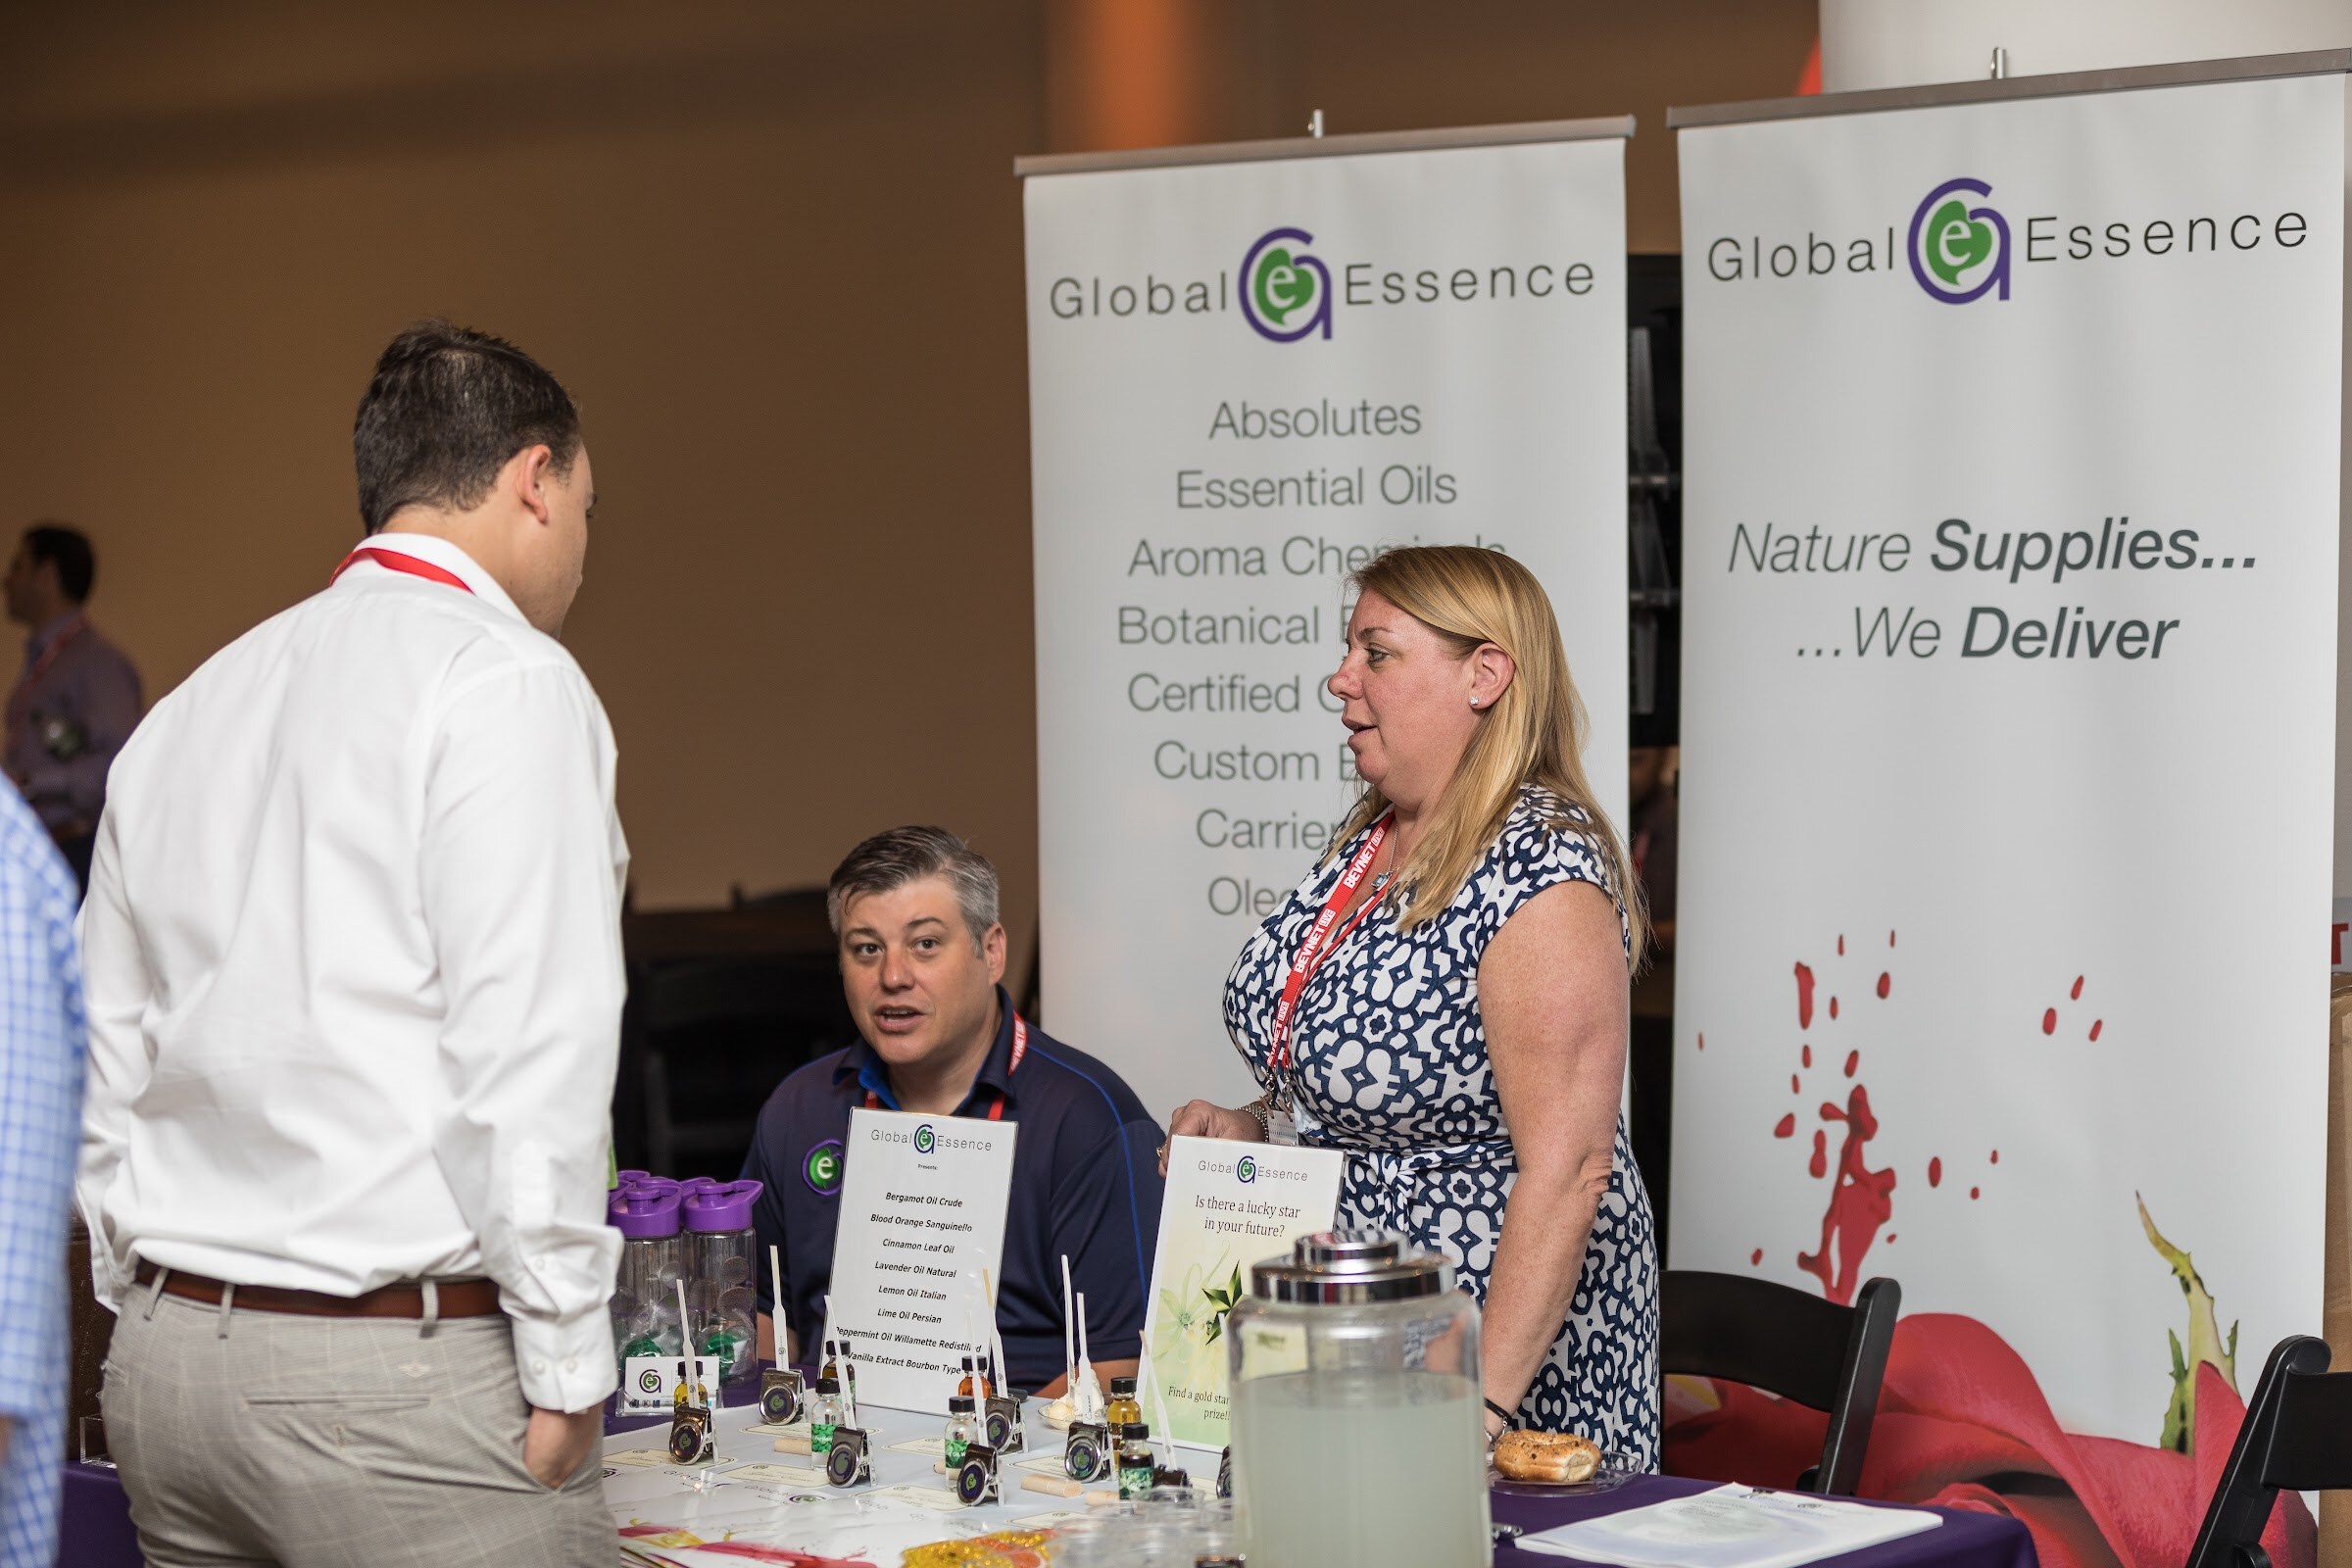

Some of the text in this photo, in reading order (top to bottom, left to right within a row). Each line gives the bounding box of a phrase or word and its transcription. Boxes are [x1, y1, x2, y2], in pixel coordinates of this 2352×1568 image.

[1707, 227, 1892, 281] Global
[2026, 211, 2307, 263] Essence
[1050, 270, 1227, 320] Global
[1345, 262, 1595, 306] Essence
[1208, 399, 1422, 440] Absolutes
[1176, 465, 1458, 510] Essential Oils
[1128, 538, 1267, 577] Aroma
[1728, 517, 2257, 584] Nature Supplies...
[1118, 606, 1319, 646] Botanical
[1796, 606, 2180, 660] ...We Deliver
[1128, 673, 1299, 713] Certified
[1154, 741, 1320, 781] Custom
[1344, 827, 1386, 889] BEVNET LIVE
[1294, 907, 1337, 974] BEVNET LIVE
[871, 1129, 912, 1144] Global
[937, 1135, 992, 1151] Essence
[1198, 1160, 1236, 1174] Global
[1257, 1166, 1308, 1181] Essence
[885, 1192, 963, 1207] Bergamot Oil Crude
[1195, 1195, 1300, 1219] Is there a lucky star
[870, 1213, 973, 1233] Blood Orange Sanguinello
[1204, 1216, 1285, 1238] in your future?
[882, 1238, 956, 1253] Cinnamon Leaf Oil
[874, 1260, 957, 1278] Lavender Oil Natural
[878, 1285, 947, 1300] Lemon Oil Italian
[877, 1308, 942, 1324] Lime Oil Persian
[881, 1332, 893, 1342] Oil
[894, 1334, 937, 1348] Willamette
[938, 1340, 982, 1353] Redistilld
[848, 1351, 961, 1375] Vanilla Extract Bourbon Type
[1168, 1386, 1187, 1398] Find
[1188, 1391, 1193, 1399] a
[1195, 1392, 1213, 1403] gold
